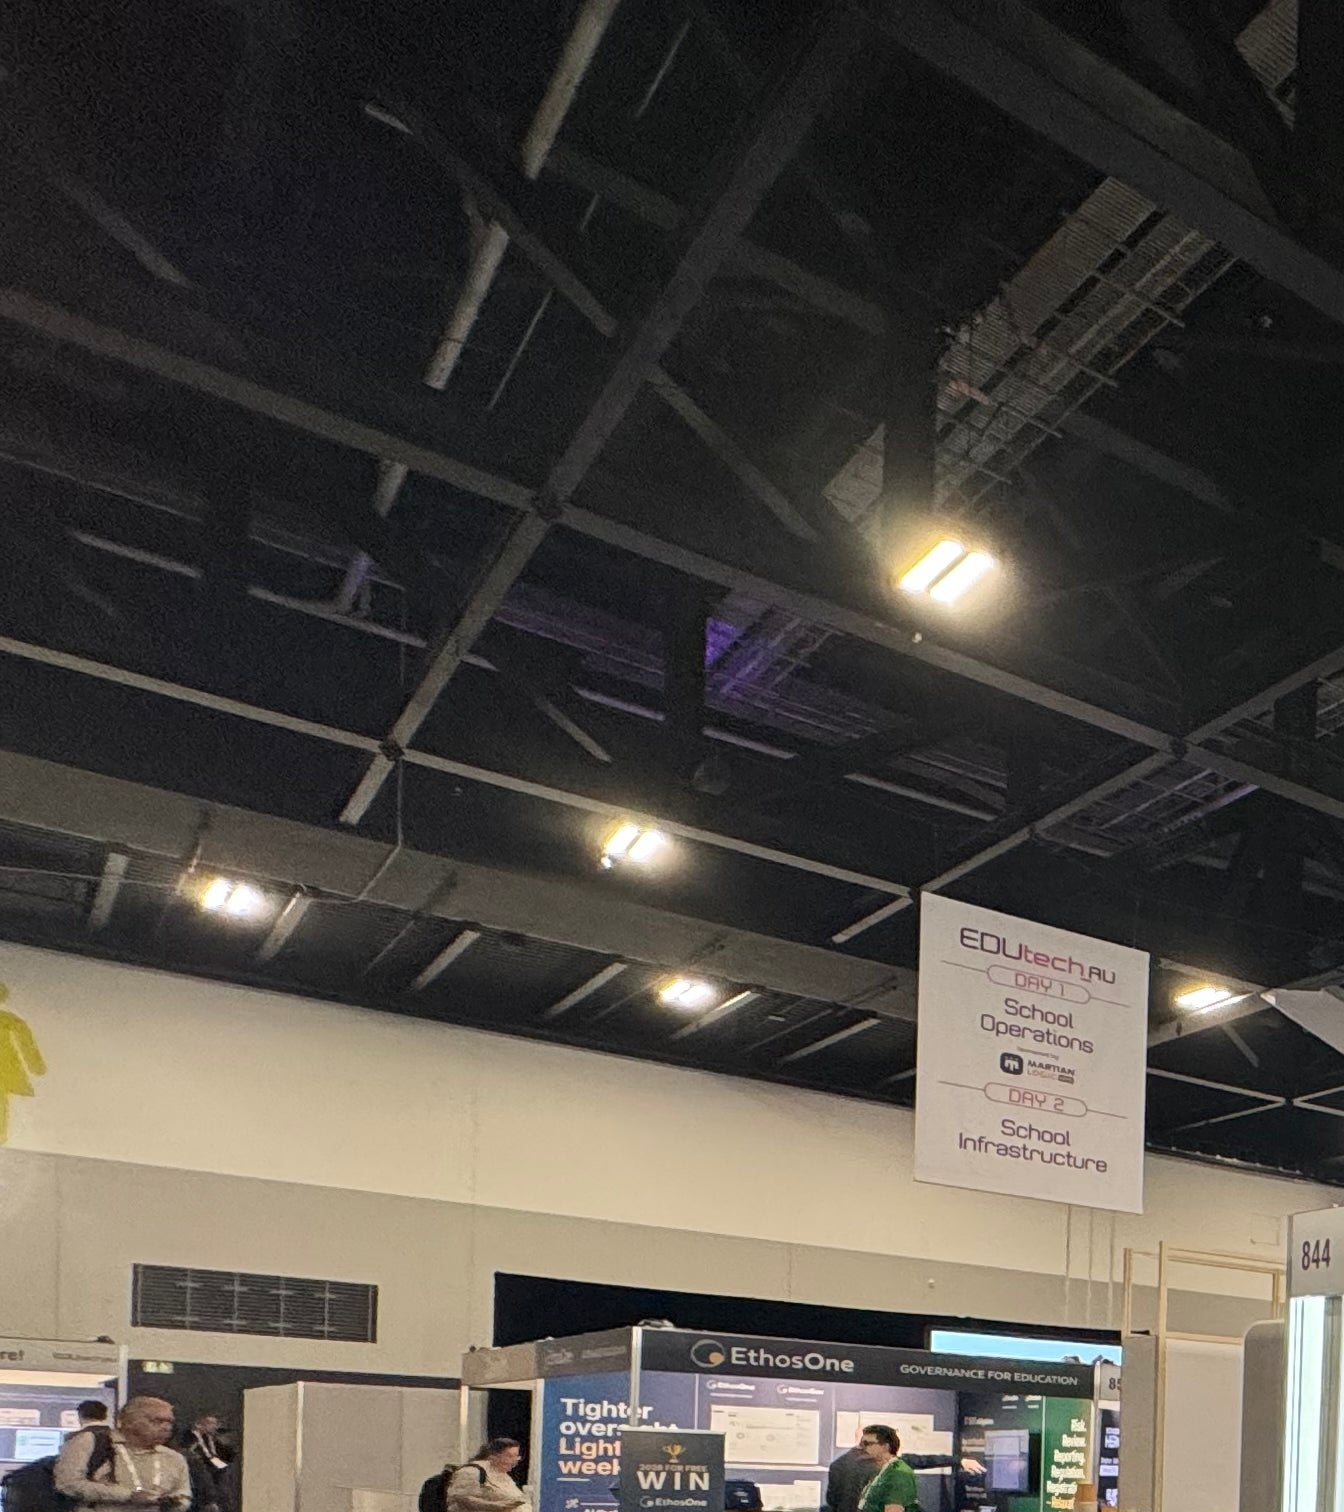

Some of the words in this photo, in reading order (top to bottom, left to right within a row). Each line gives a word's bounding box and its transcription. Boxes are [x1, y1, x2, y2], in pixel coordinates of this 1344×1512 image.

[1014, 973, 1053, 994] DAY
[1004, 998, 1074, 1029] School
[980, 1014, 1095, 1054] Operations
[1008, 1088, 1047, 1108] DAY
[1054, 1097, 1065, 1112] 2
[1001, 1119, 1070, 1147] School
[958, 1132, 1108, 1173] Infrastructure
[1301, 1238, 1331, 1271] 844
[731, 1346, 855, 1373] EthosOne
[900, 1364, 986, 1380] GOVERNANCE
[987, 1369, 1012, 1382] FOR
[1013, 1372, 1078, 1386] EDUCATION
[636, 1470, 710, 1491] WIN
[655, 1497, 708, 1507] EthosOne
